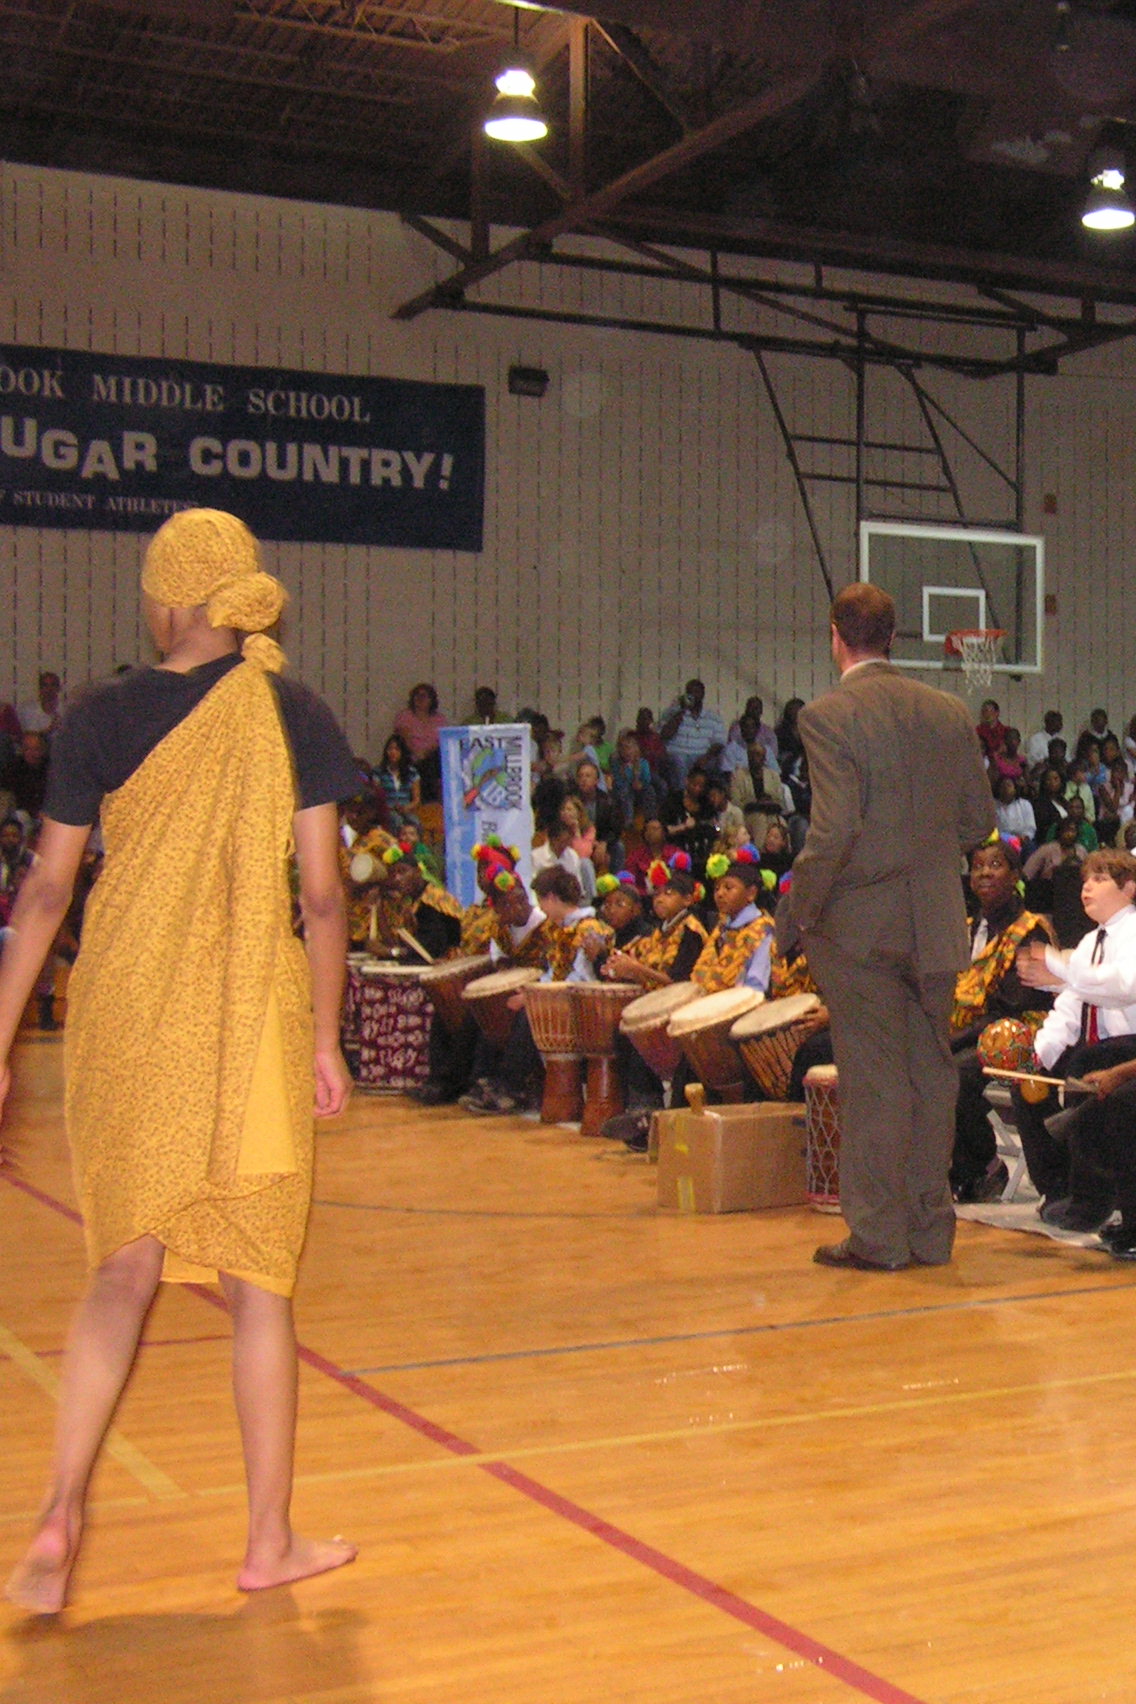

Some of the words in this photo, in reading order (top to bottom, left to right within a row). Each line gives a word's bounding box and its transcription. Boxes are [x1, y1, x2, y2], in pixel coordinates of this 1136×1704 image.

[92, 374, 226, 413] MIDDLE
[248, 389, 370, 423] SCHOOL
[1, 416, 158, 481] UGAR
[189, 436, 454, 491] COUNTRY!
[13, 490, 96, 509] STUDENT
[459, 736, 503, 749] EAST
